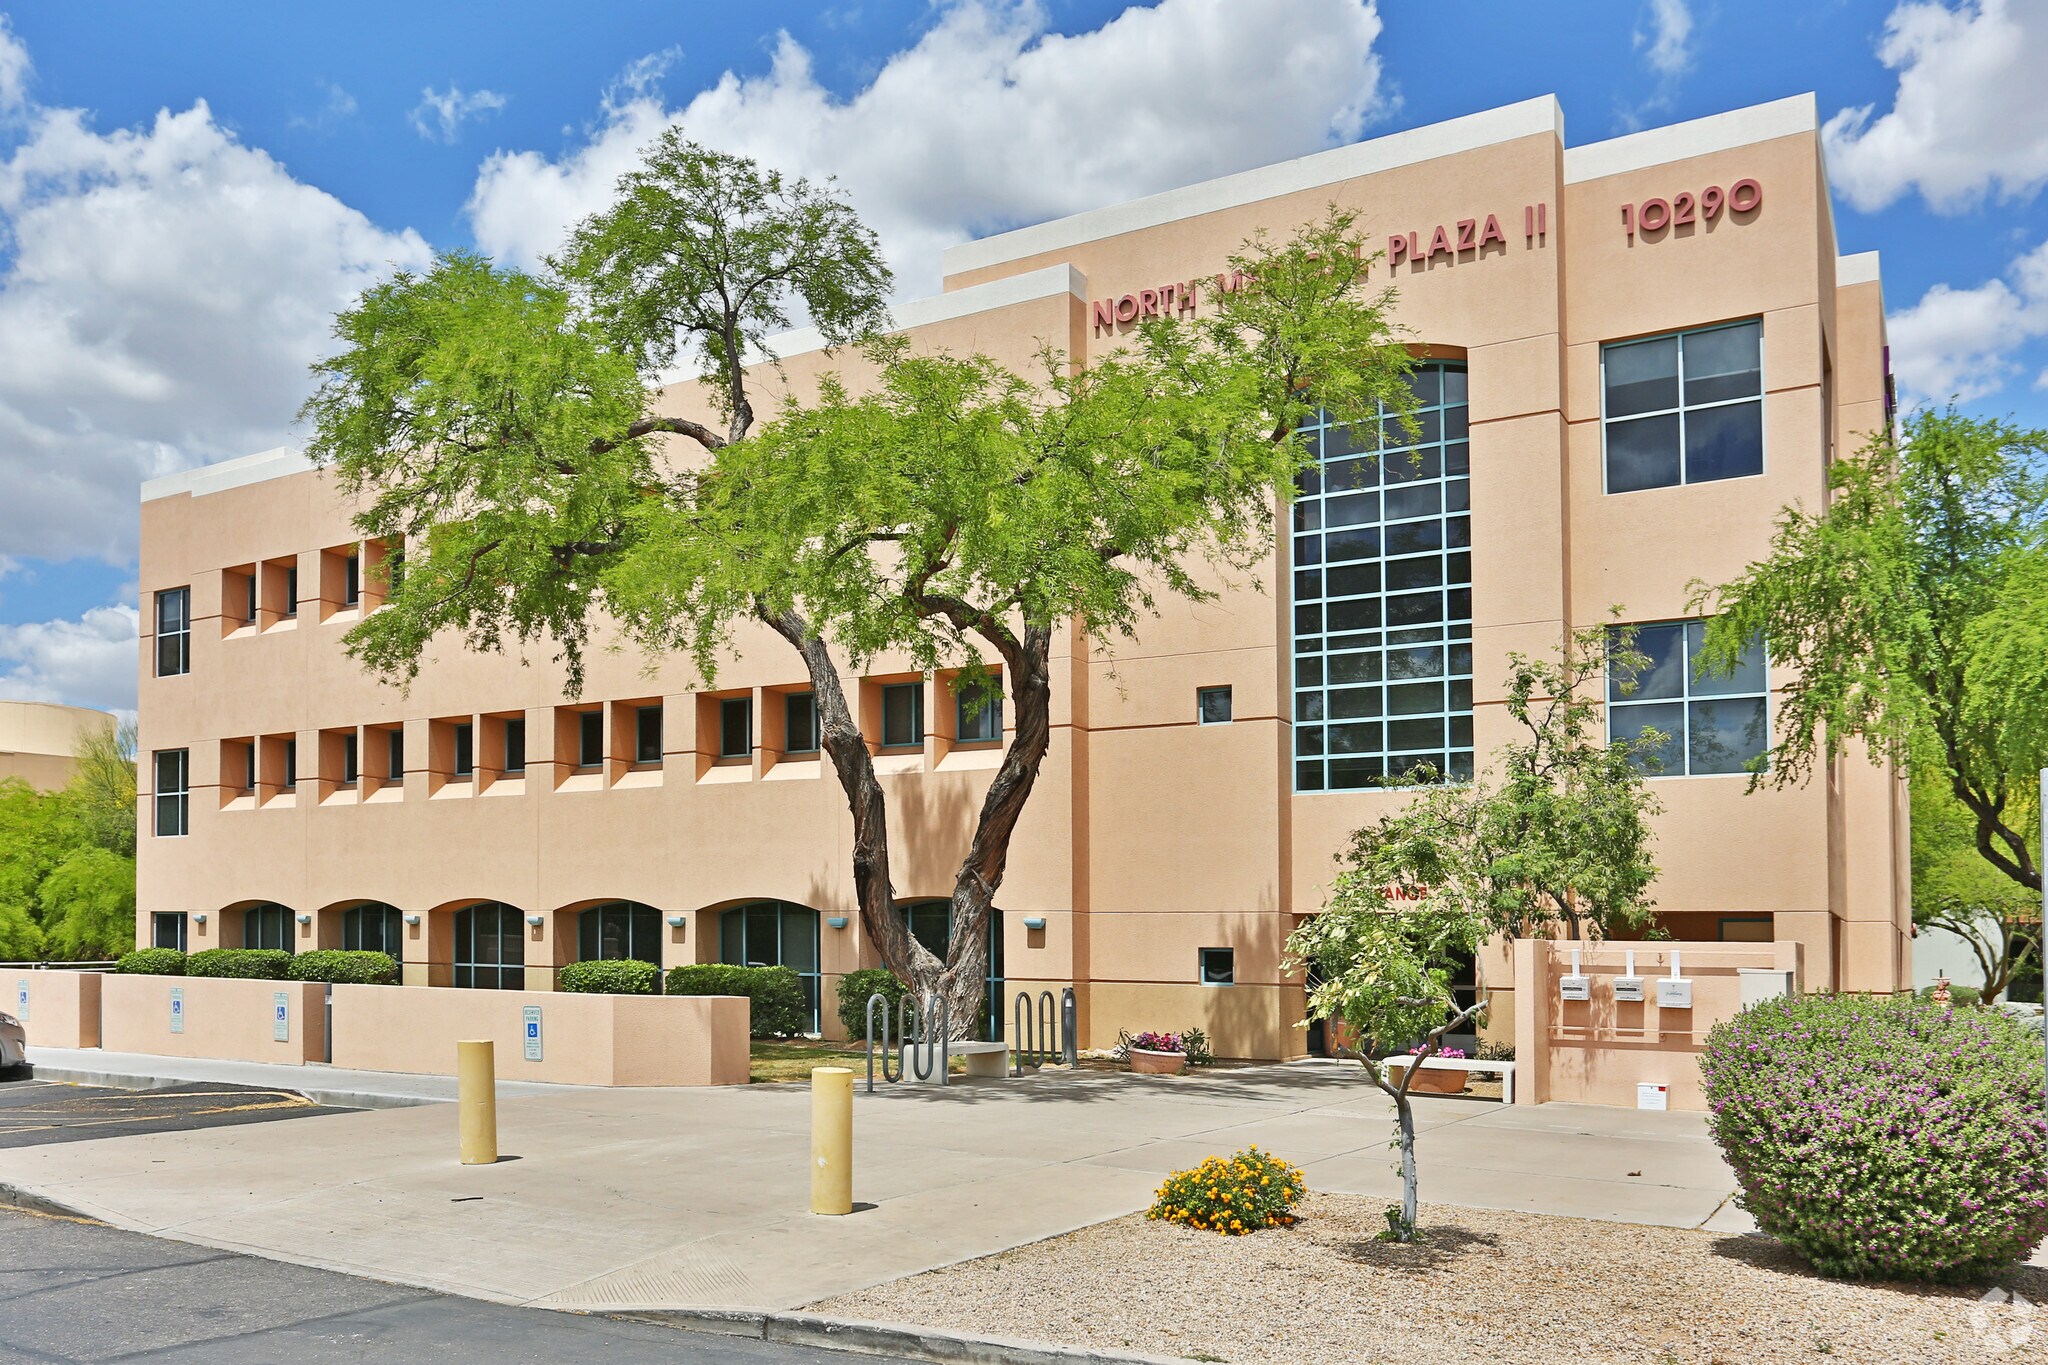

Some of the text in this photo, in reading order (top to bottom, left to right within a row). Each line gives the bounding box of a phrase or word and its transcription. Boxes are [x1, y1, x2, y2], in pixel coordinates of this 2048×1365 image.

[1621, 178, 1763, 236] 10290
[1093, 203, 1547, 328] NORTH PLAZA II
